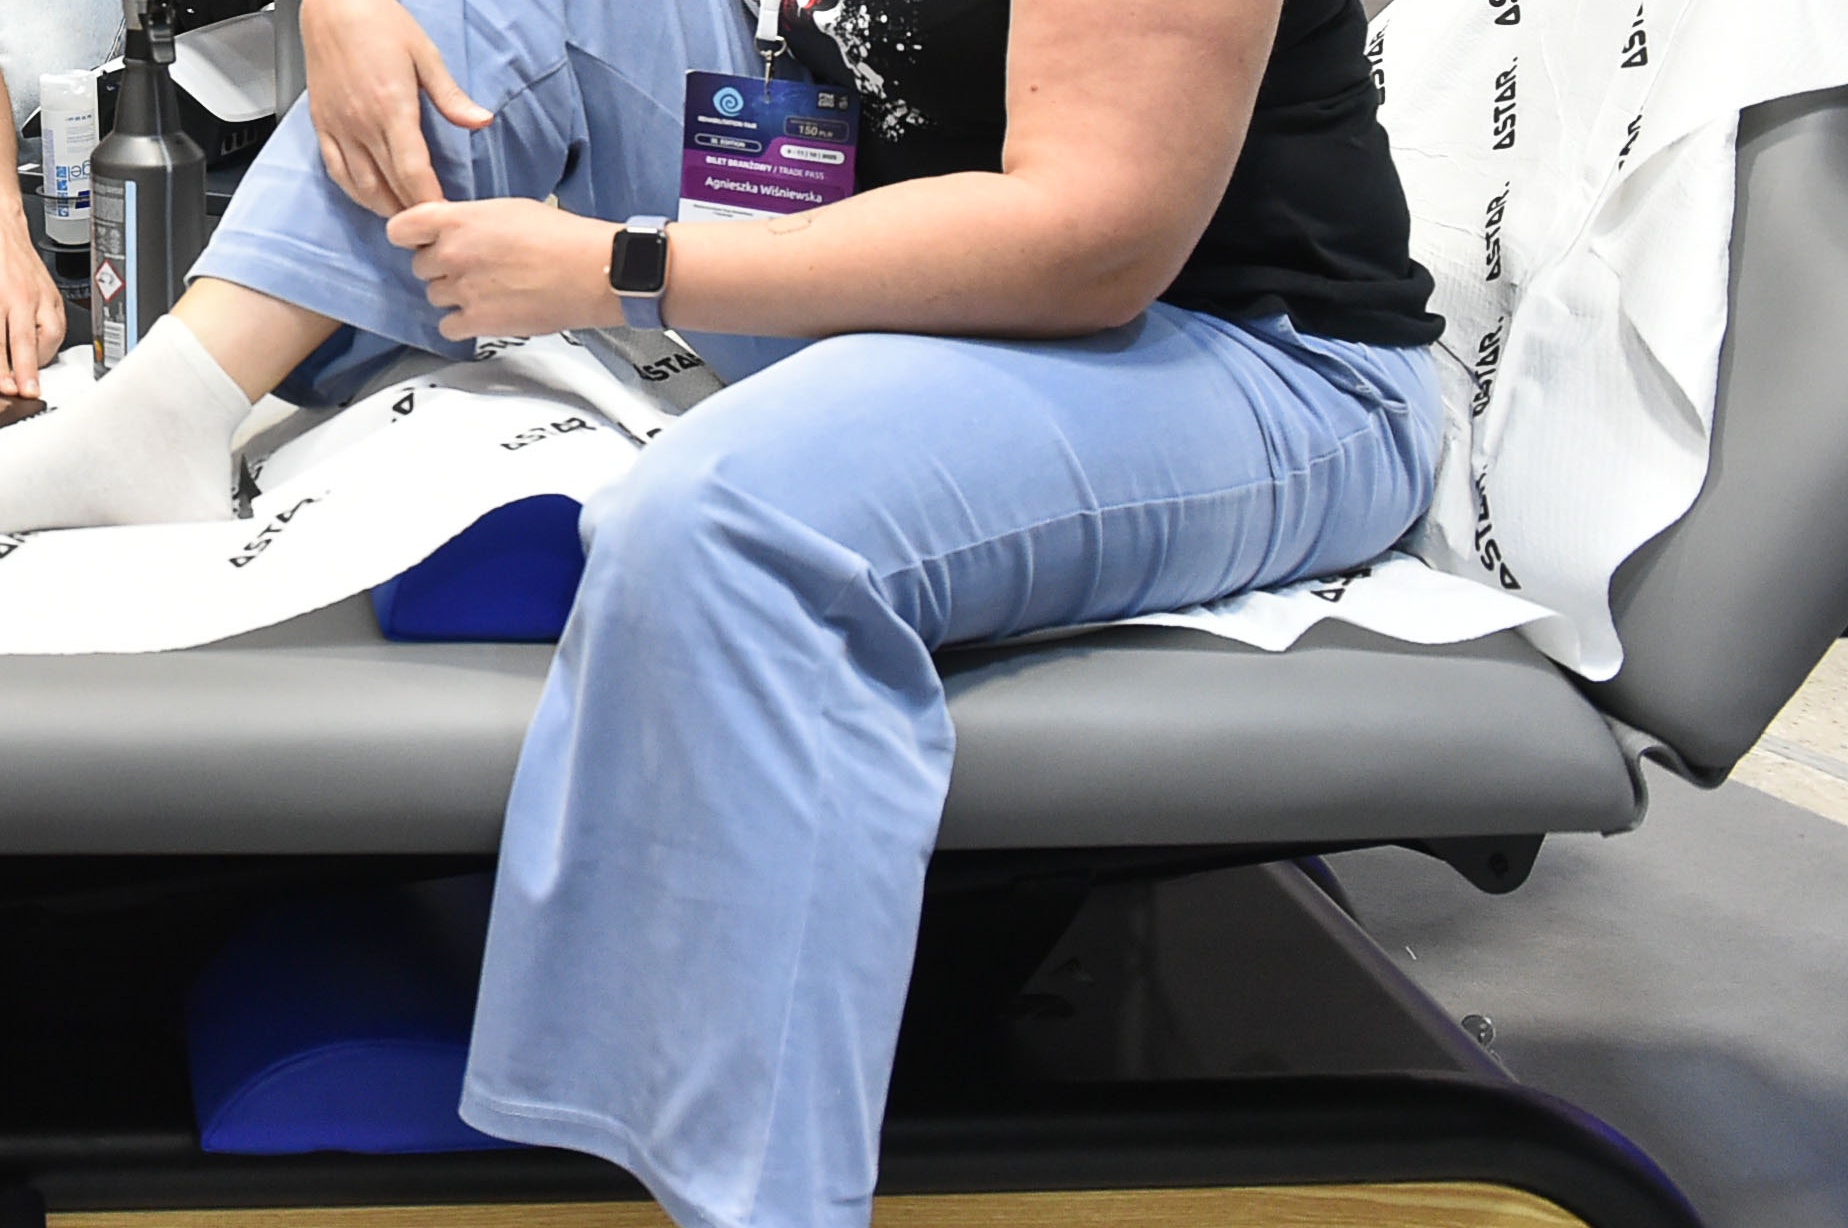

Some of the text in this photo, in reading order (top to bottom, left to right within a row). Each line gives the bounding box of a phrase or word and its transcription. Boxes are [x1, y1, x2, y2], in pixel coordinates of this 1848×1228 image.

[1492, 57, 1519, 150] ASTAR.
[799, 125, 818, 136] 150
[704, 176, 823, 203] Agnieszka Wiśniewska
